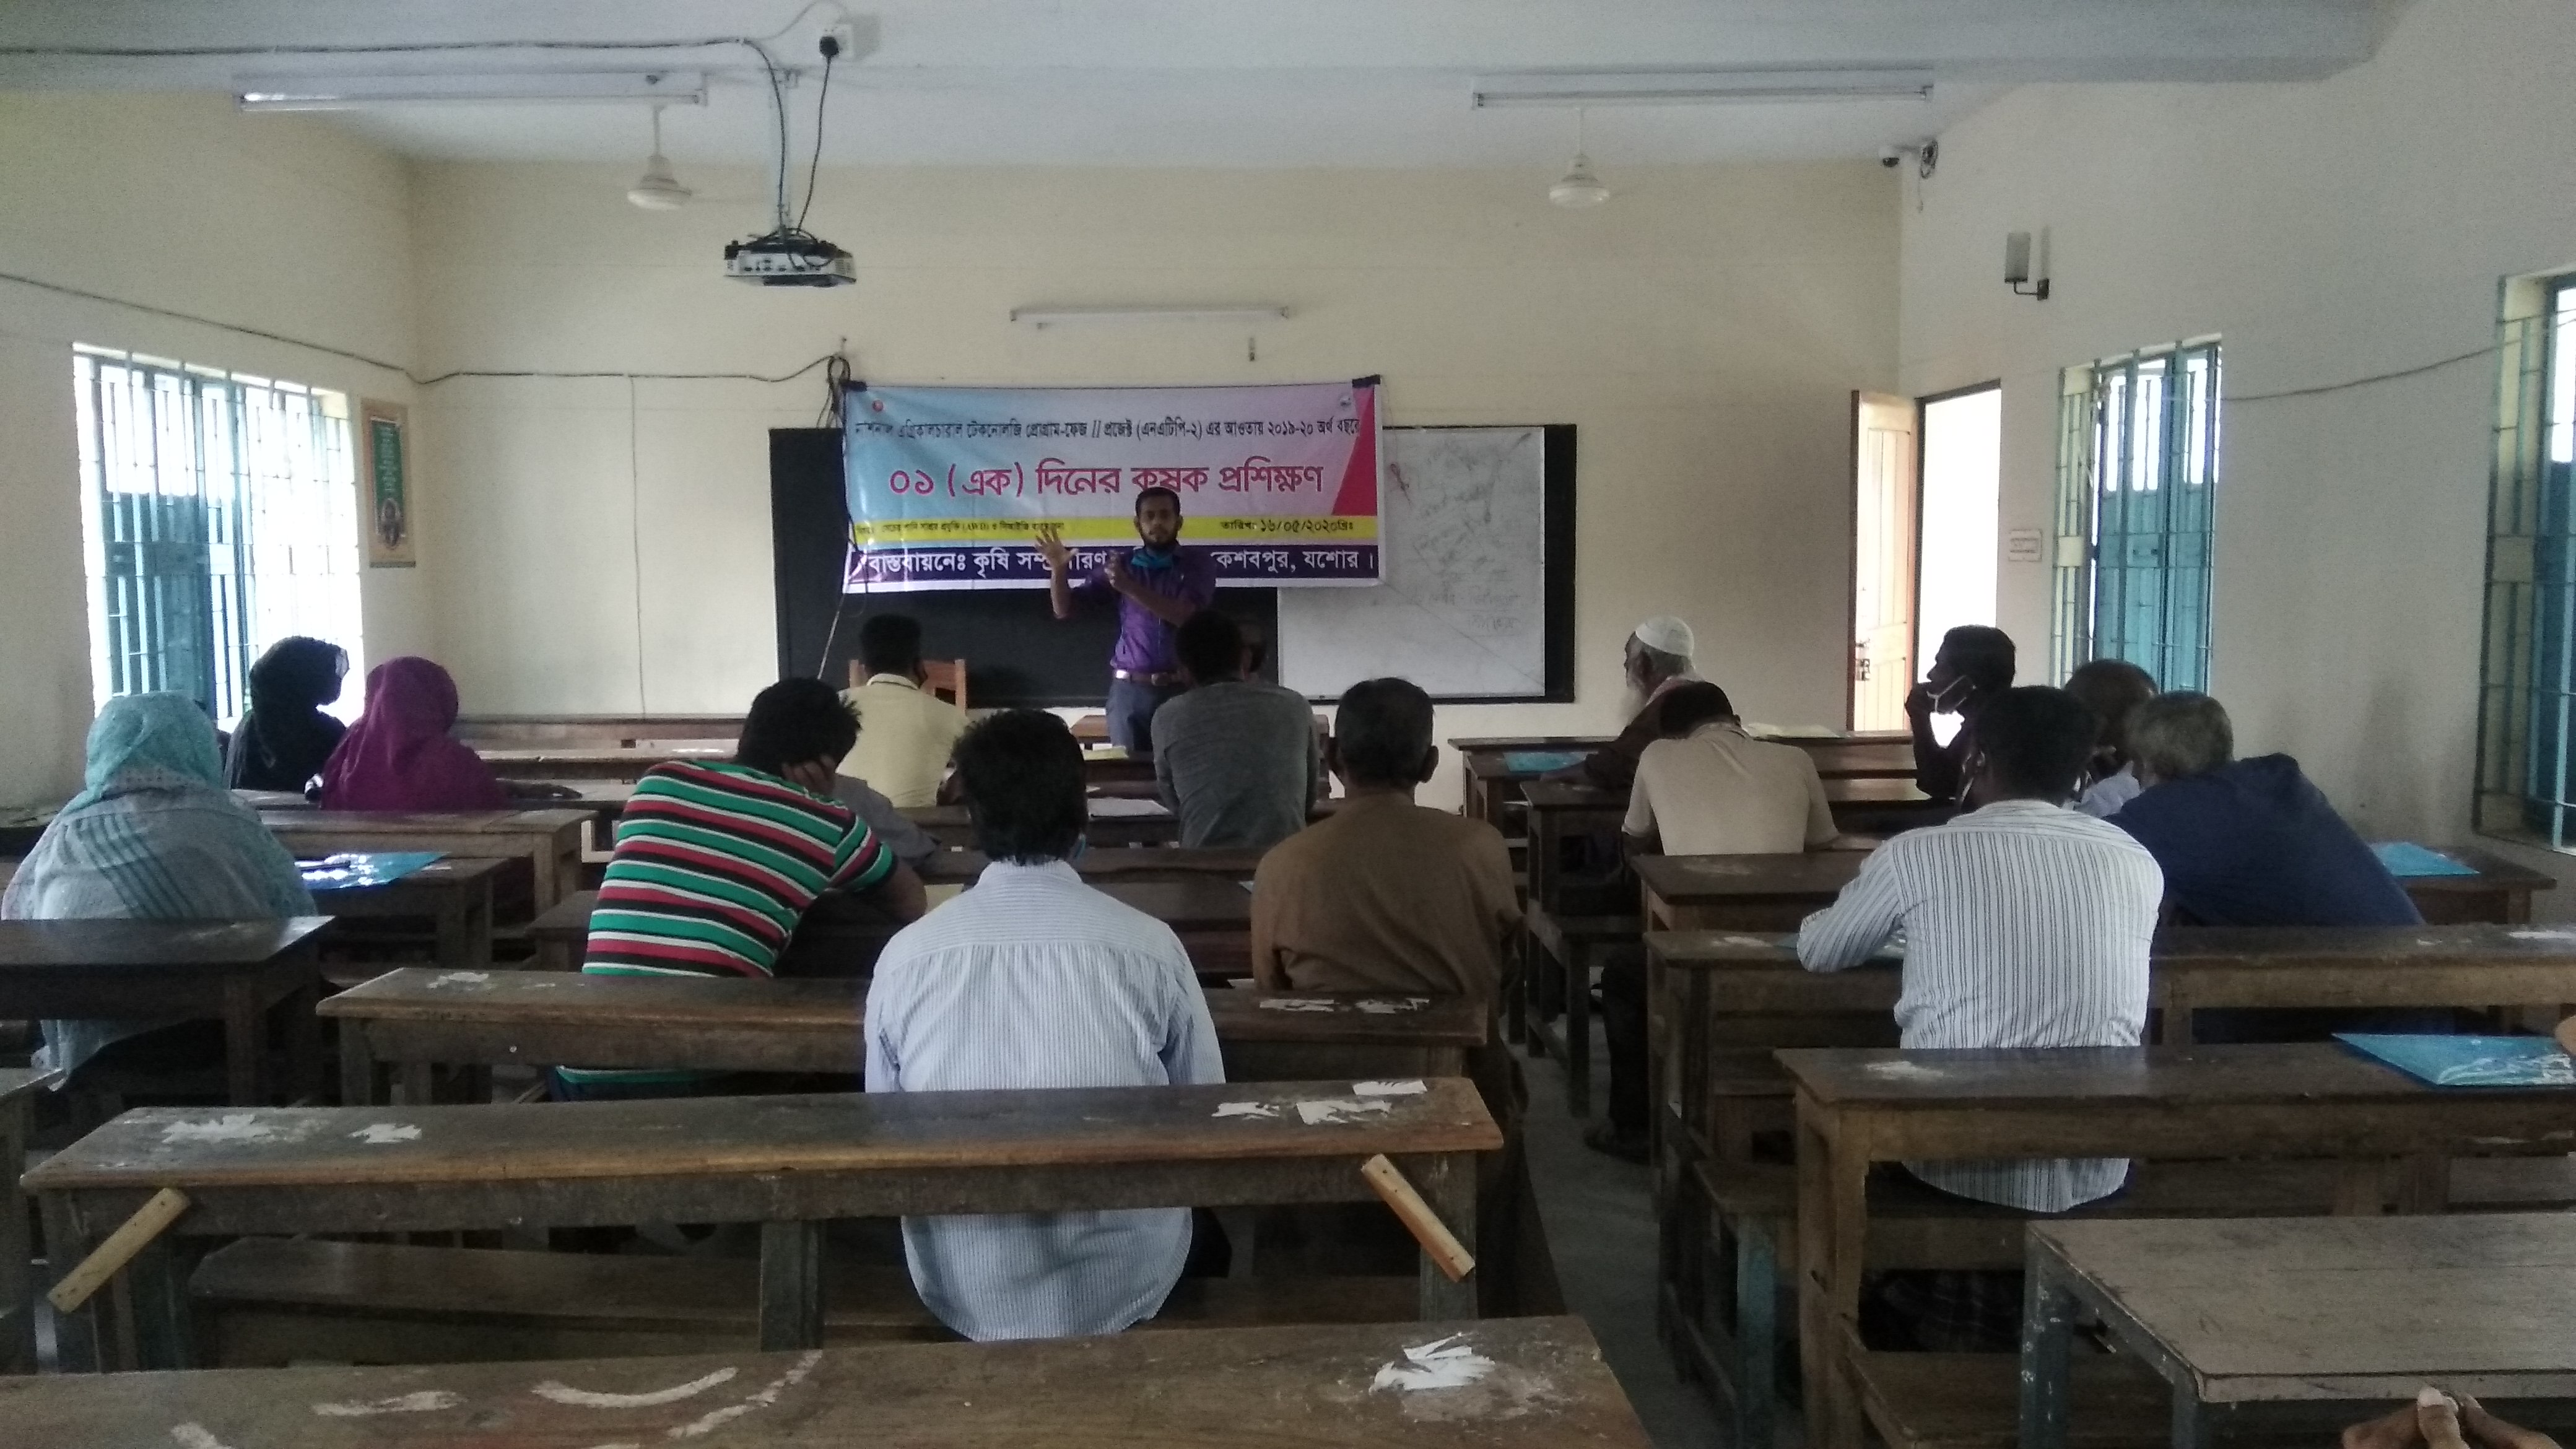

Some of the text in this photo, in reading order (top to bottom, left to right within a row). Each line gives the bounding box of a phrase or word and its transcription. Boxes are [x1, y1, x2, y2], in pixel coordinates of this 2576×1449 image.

[1206, 422, 1221, 435] এর
[1224, 422, 1264, 436] আওতায়
[1268, 420, 1313, 437] ২০১৯-২০
[889, 469, 934, 494] ০১
[1035, 458, 1122, 495] দিনের
[1131, 468, 1209, 493] কষক
[1219, 455, 1324, 492] প্রশিক্ষণ
[867, 552, 966, 572] বাস্তবায়নেঃ
[972, 547, 1010, 578] কৃষি
[1302, 550, 1359, 569] যশোর
